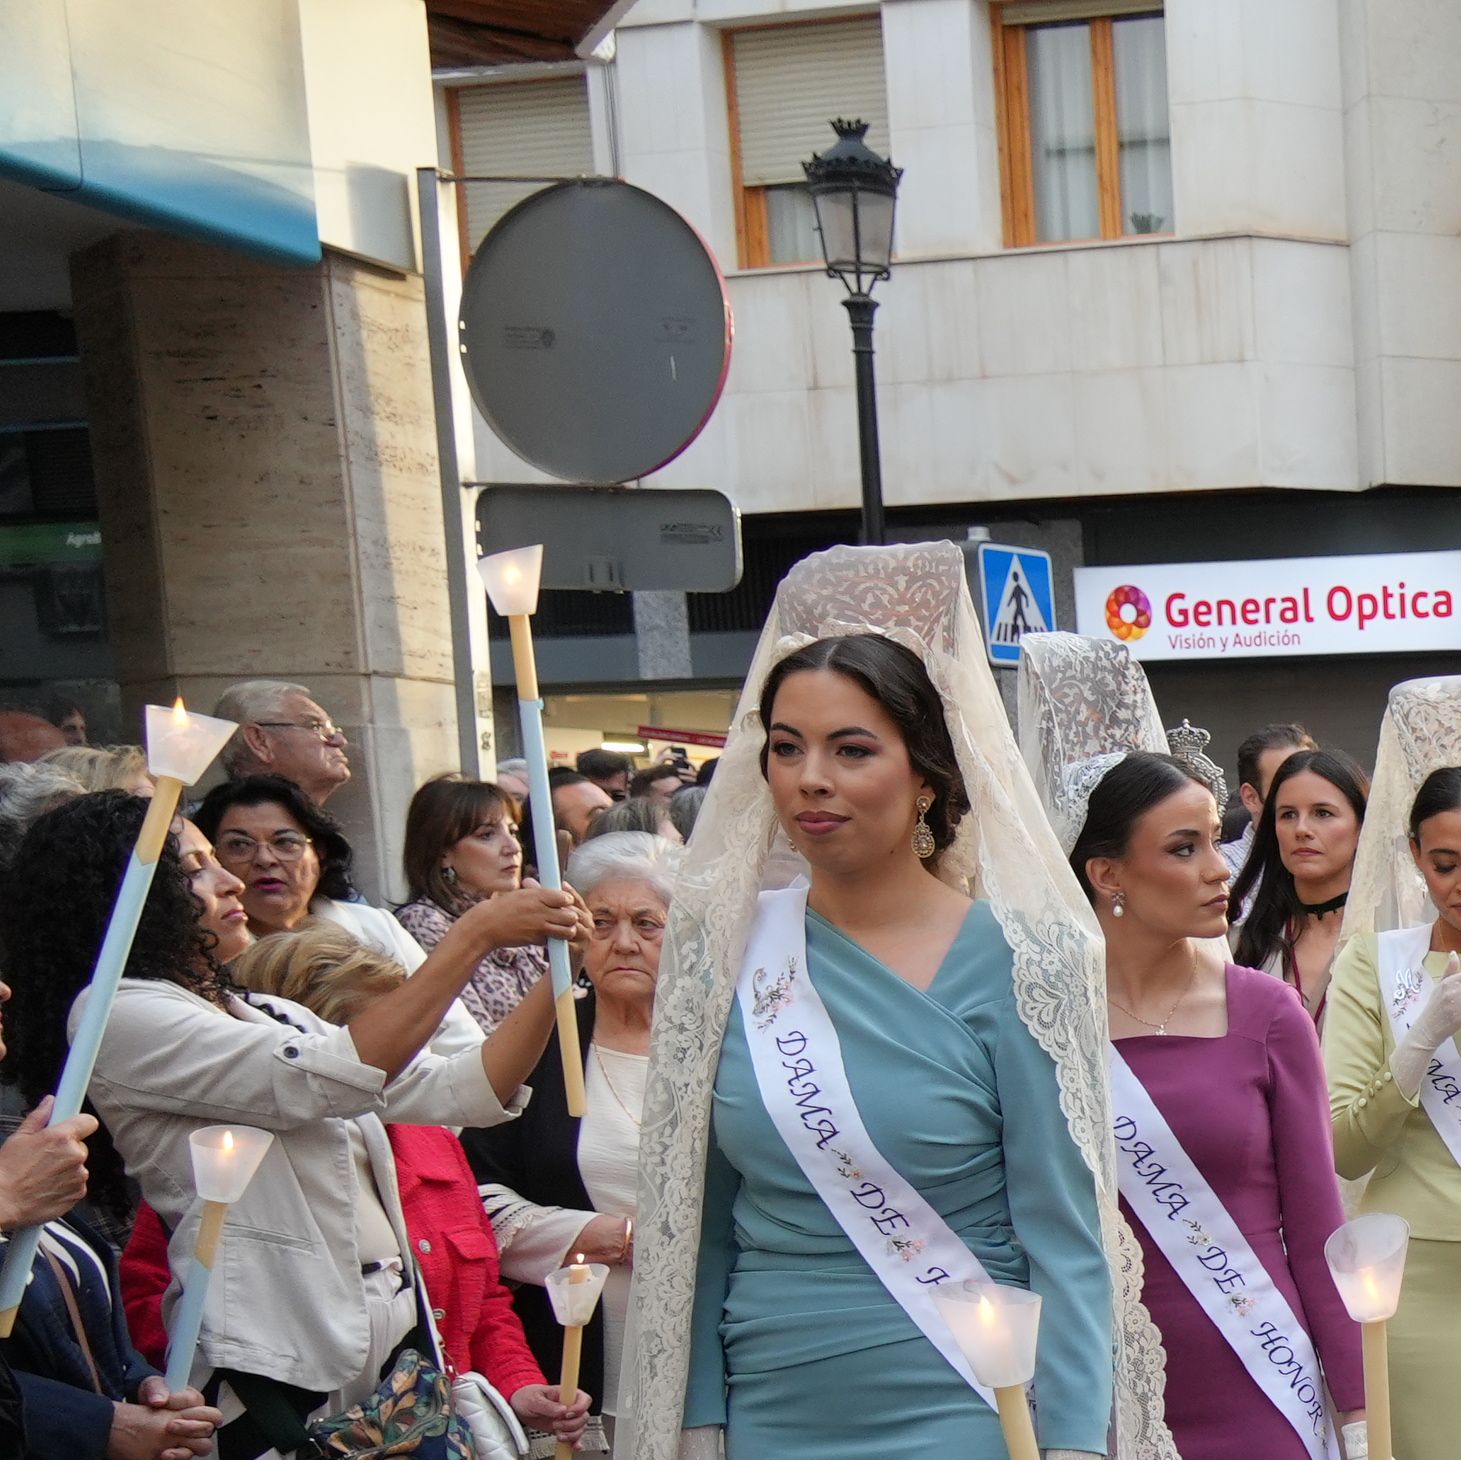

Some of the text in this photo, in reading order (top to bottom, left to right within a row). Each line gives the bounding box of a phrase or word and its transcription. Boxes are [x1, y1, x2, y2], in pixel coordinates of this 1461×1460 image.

[1165, 581, 1453, 631] General Optica
[1168, 630, 1301, 652] Visión y Audición
[775, 1030, 912, 1237] DAMA DE
[1113, 1115, 1325, 1437] DAMA DE HONOR
